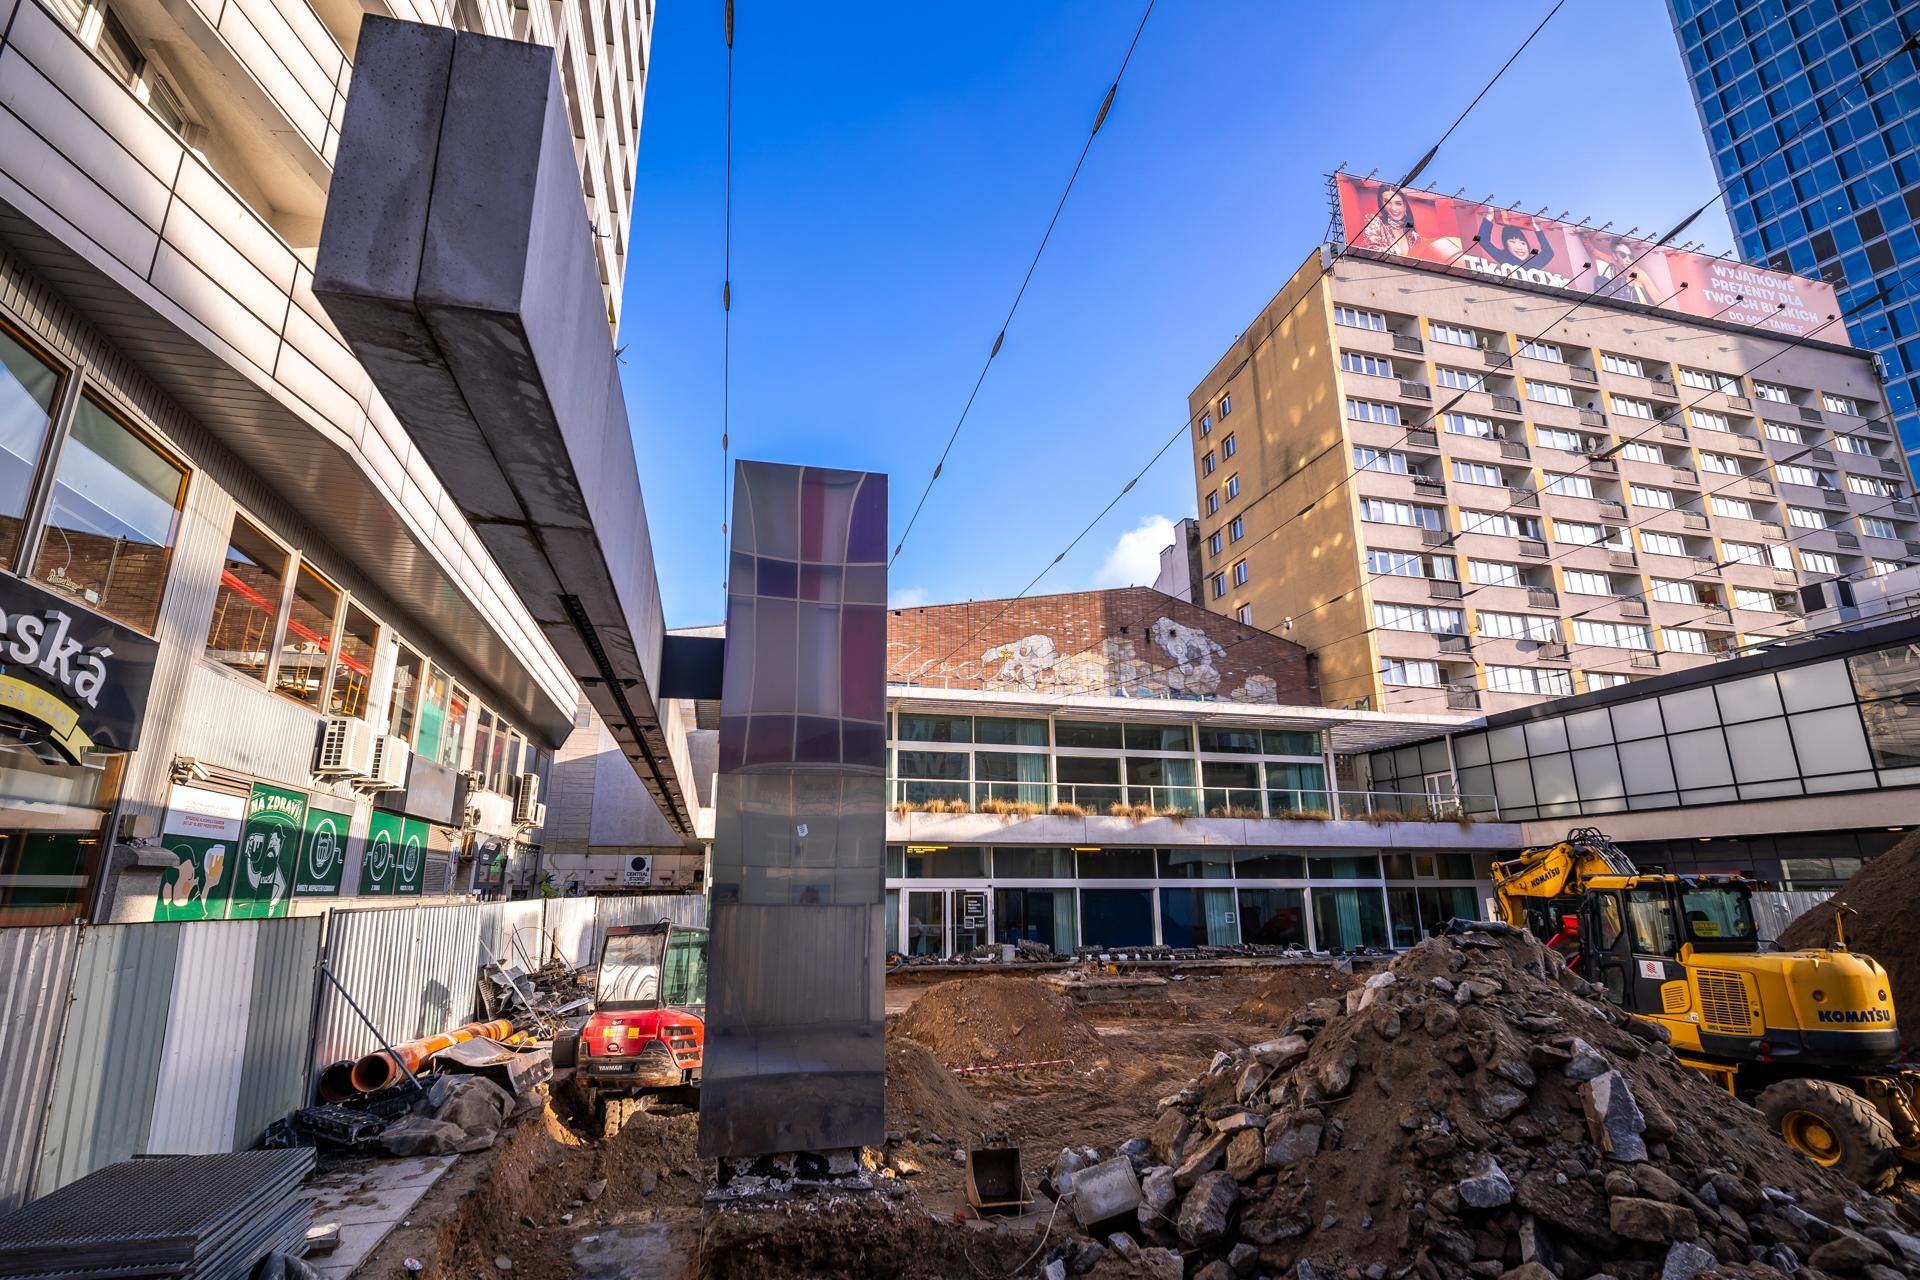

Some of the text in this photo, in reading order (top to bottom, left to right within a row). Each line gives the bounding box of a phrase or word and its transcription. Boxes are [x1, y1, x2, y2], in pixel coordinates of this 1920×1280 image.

[1712, 264, 1795, 292] WYJĄTKOWE
[1711, 278, 1804, 307] PREZENTY DLA
[1728, 311, 1744, 322] DO
[1770, 319, 1804, 334] TANIEJ
[0, 607, 115, 709] ská
[1530, 866, 1561, 888] KOMATSU
[1818, 1007, 1890, 1023] KOMATSU
